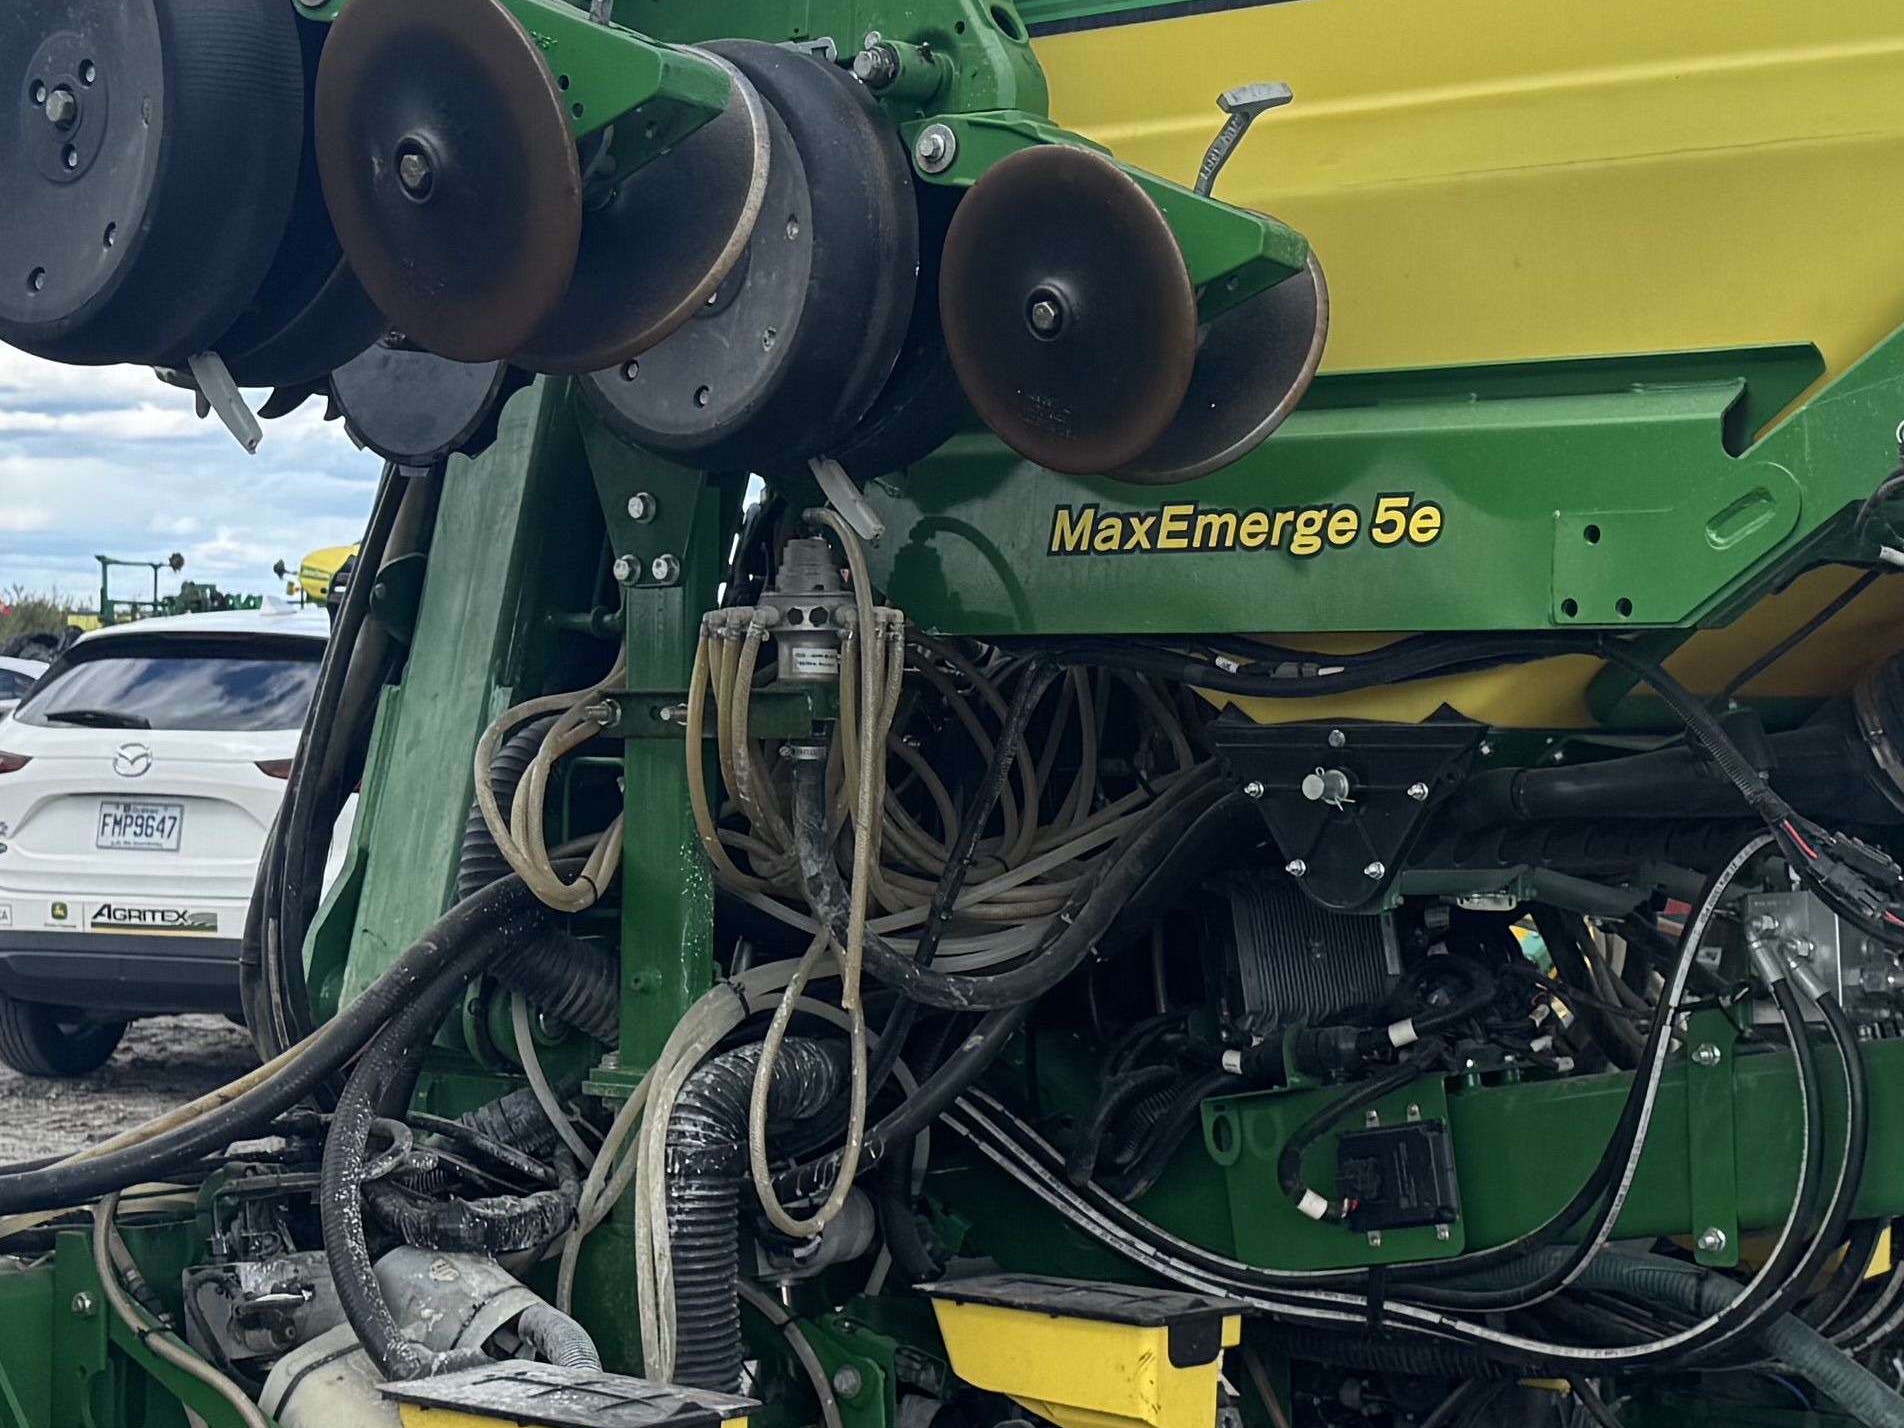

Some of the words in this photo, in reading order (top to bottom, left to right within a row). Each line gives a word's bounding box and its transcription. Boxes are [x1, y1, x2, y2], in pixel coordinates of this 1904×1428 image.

[1050, 503, 1360, 556] MaxEmerge
[1370, 496, 1441, 544] 5e
[100, 813, 178, 840] FMP9647
[92, 903, 188, 923] AGRITEX
